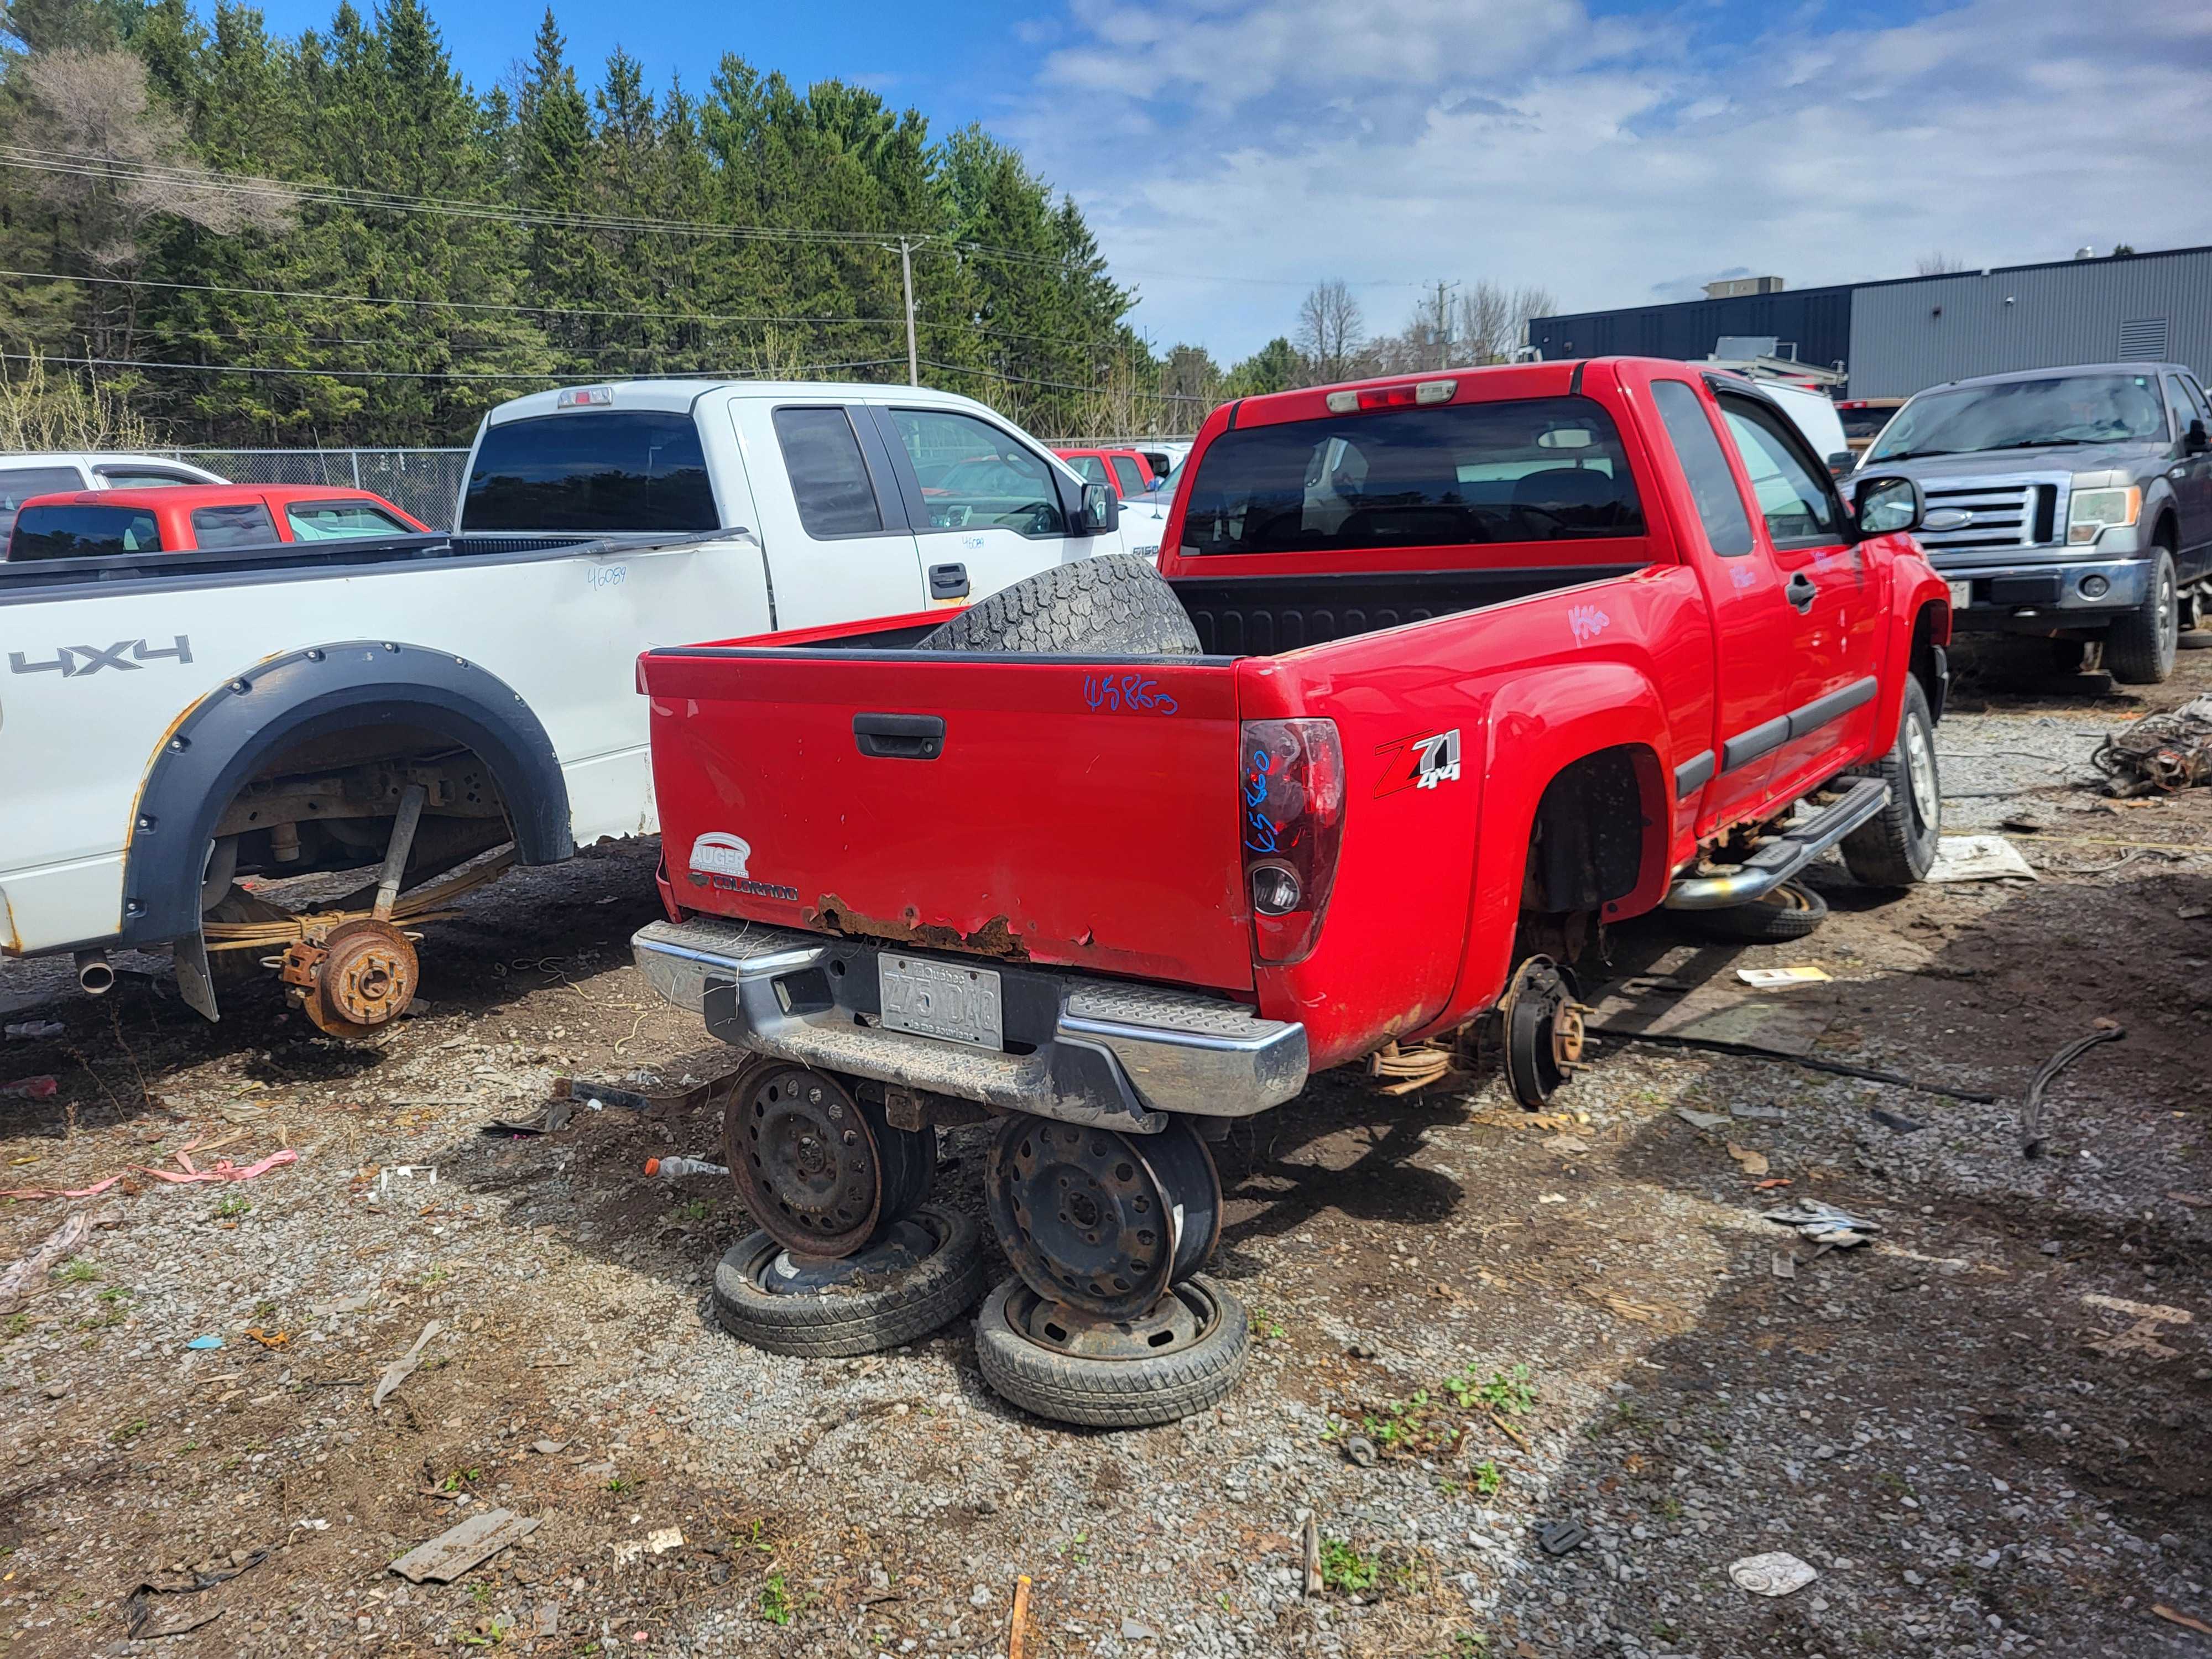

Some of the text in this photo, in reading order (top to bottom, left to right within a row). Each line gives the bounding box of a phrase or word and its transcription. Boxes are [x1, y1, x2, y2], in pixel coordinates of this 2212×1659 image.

[587, 566, 627, 592] 46089
[1373, 728, 1460, 800] Z71
[691, 847, 746, 870] AUGER
[713, 875, 798, 901] COLORADO
[924, 967, 965, 985] Québec
[908, 1019, 974, 1041] Je me souviens
